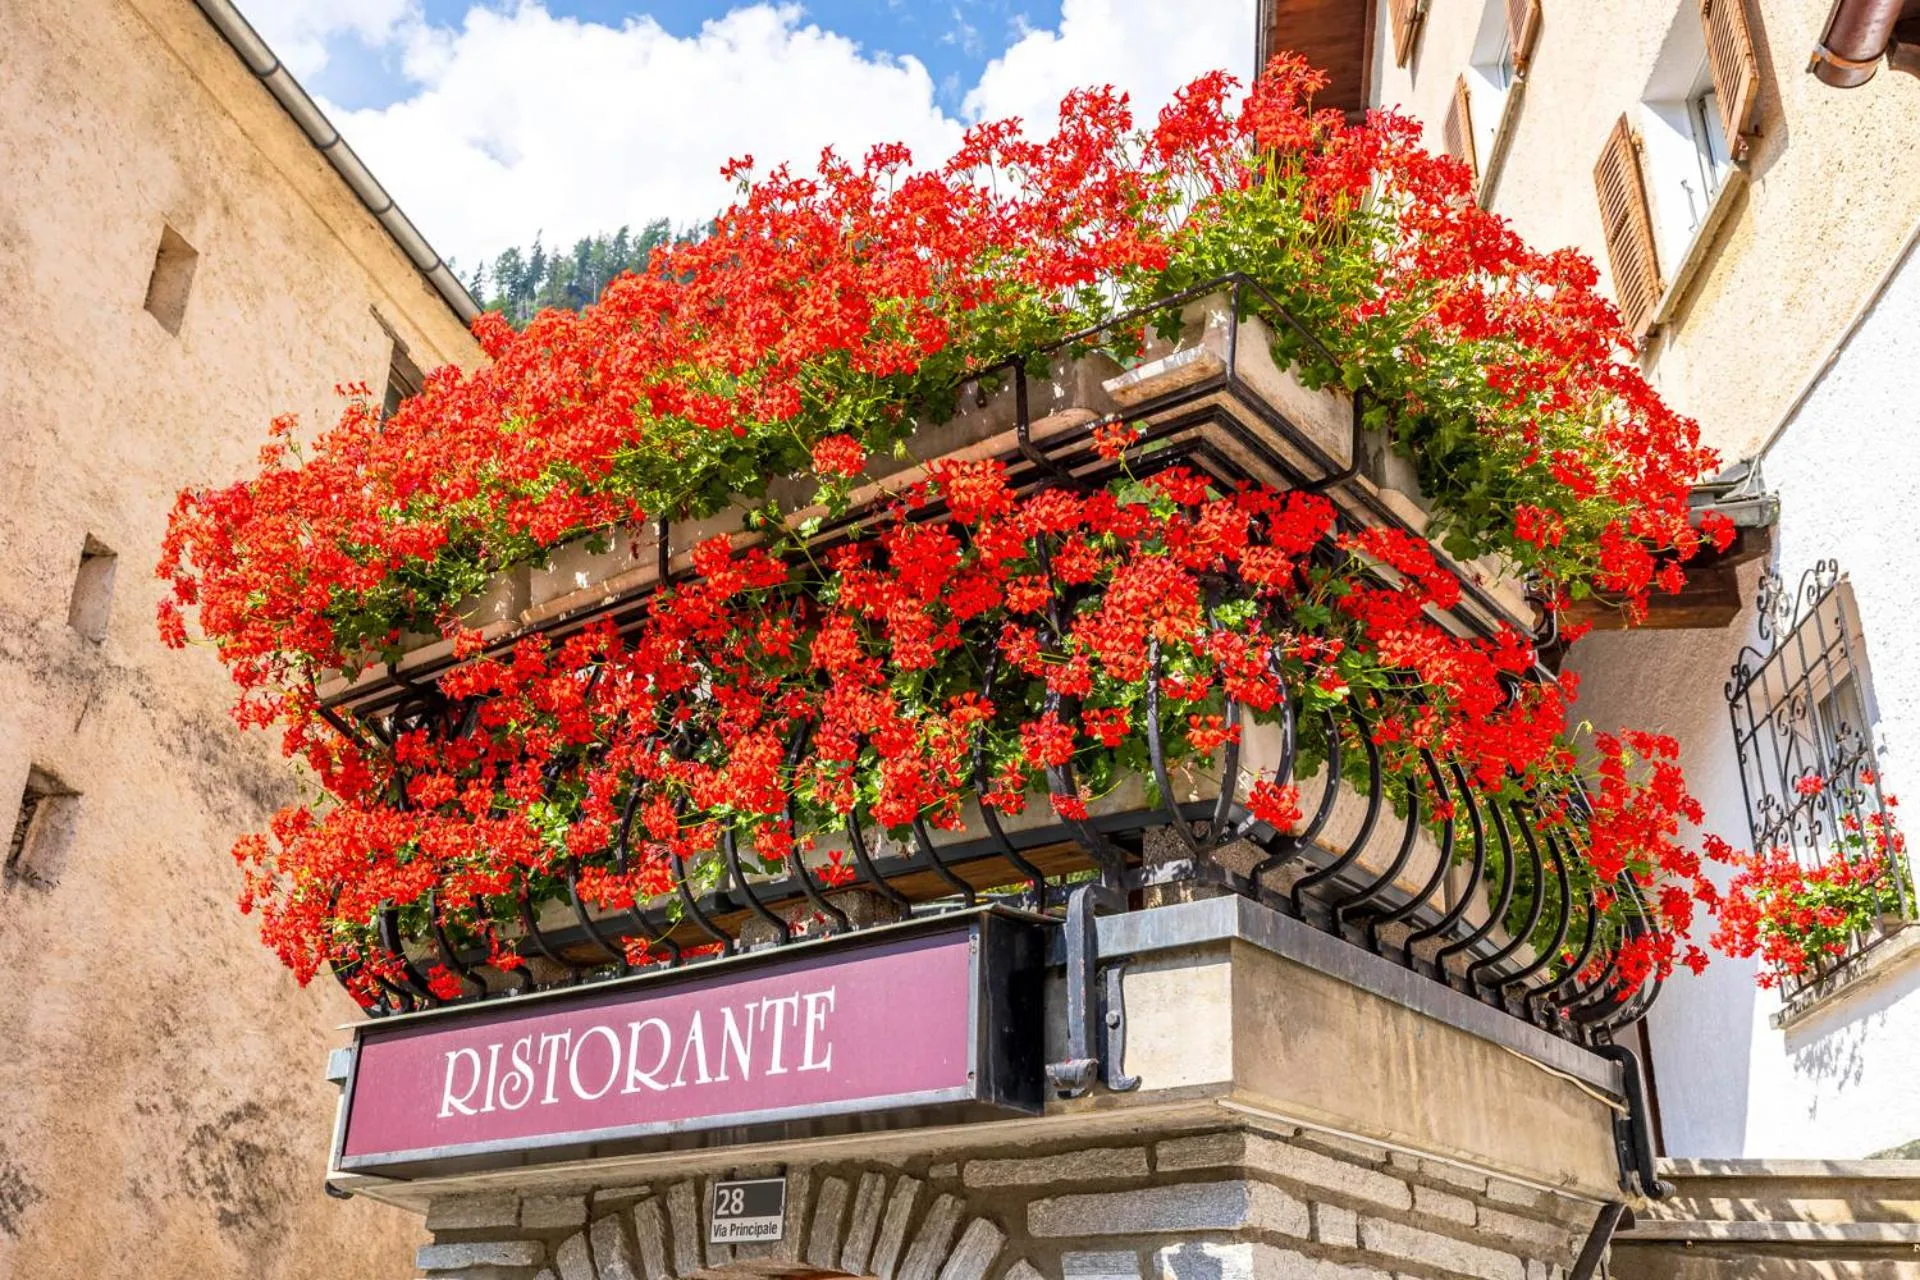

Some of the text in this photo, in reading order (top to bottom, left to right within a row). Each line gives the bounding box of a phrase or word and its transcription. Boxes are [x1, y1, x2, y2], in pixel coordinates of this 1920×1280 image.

[437, 985, 836, 1118] RISTORANTE
[716, 1188, 745, 1215] 28
[713, 1222, 778, 1237] Via Principale
